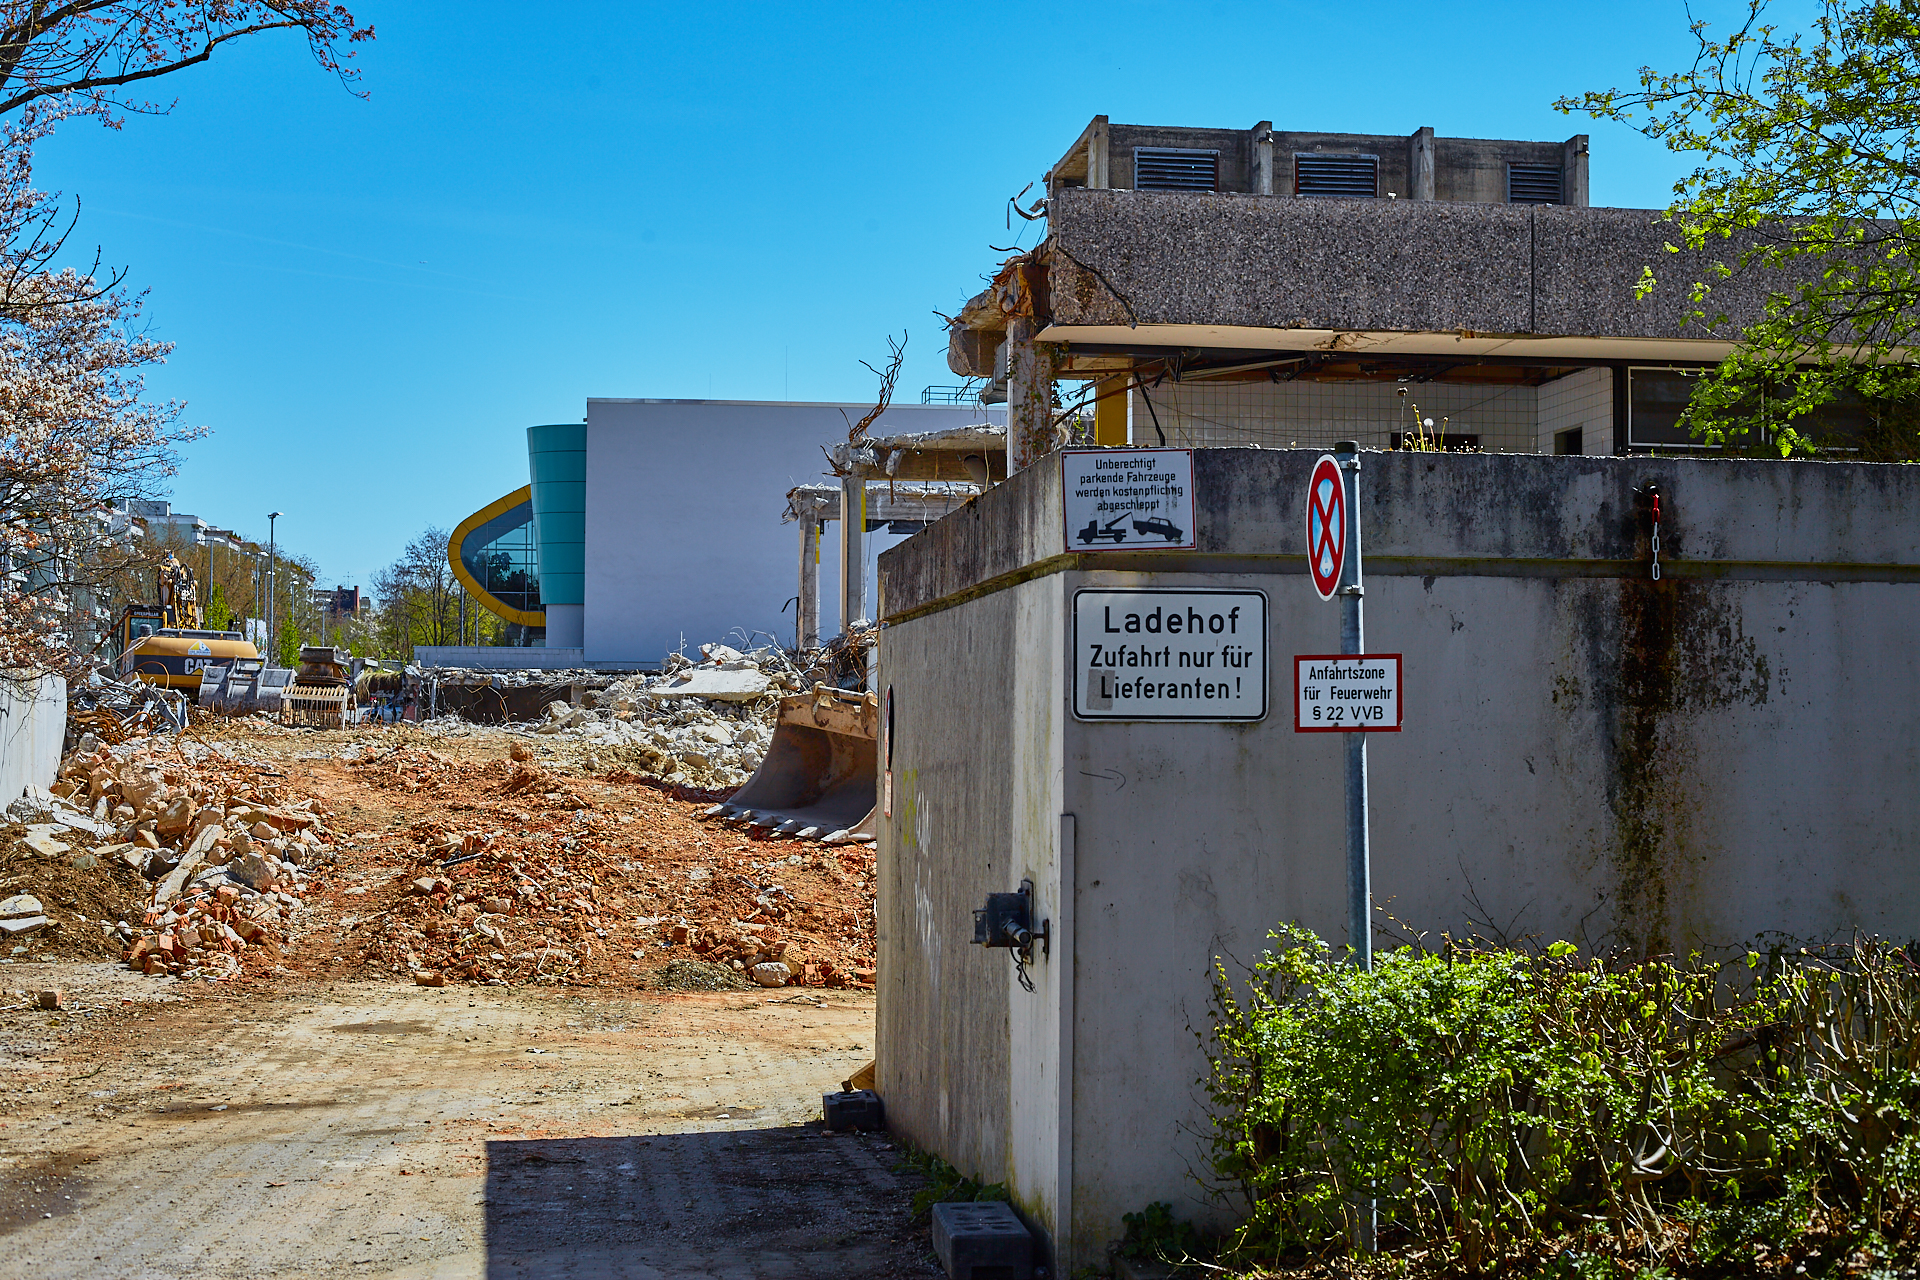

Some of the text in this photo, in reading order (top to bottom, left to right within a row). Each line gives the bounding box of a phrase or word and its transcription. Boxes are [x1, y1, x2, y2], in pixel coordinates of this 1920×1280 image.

[1095, 457, 1157, 470] Unberechtigt
[1080, 471, 1176, 486] parkende Fahrzeuge
[1075, 484, 1183, 498] werden kostenpflichtig
[1097, 499, 1160, 512] abgeschleppt
[1104, 605, 1241, 634] Ladehof
[1090, 644, 1253, 668] Zufahrt nur für
[1309, 665, 1385, 680] Anfahrtszone
[1303, 685, 1393, 700] für Feuerwehr
[1312, 705, 1383, 721] § 22 VVB
